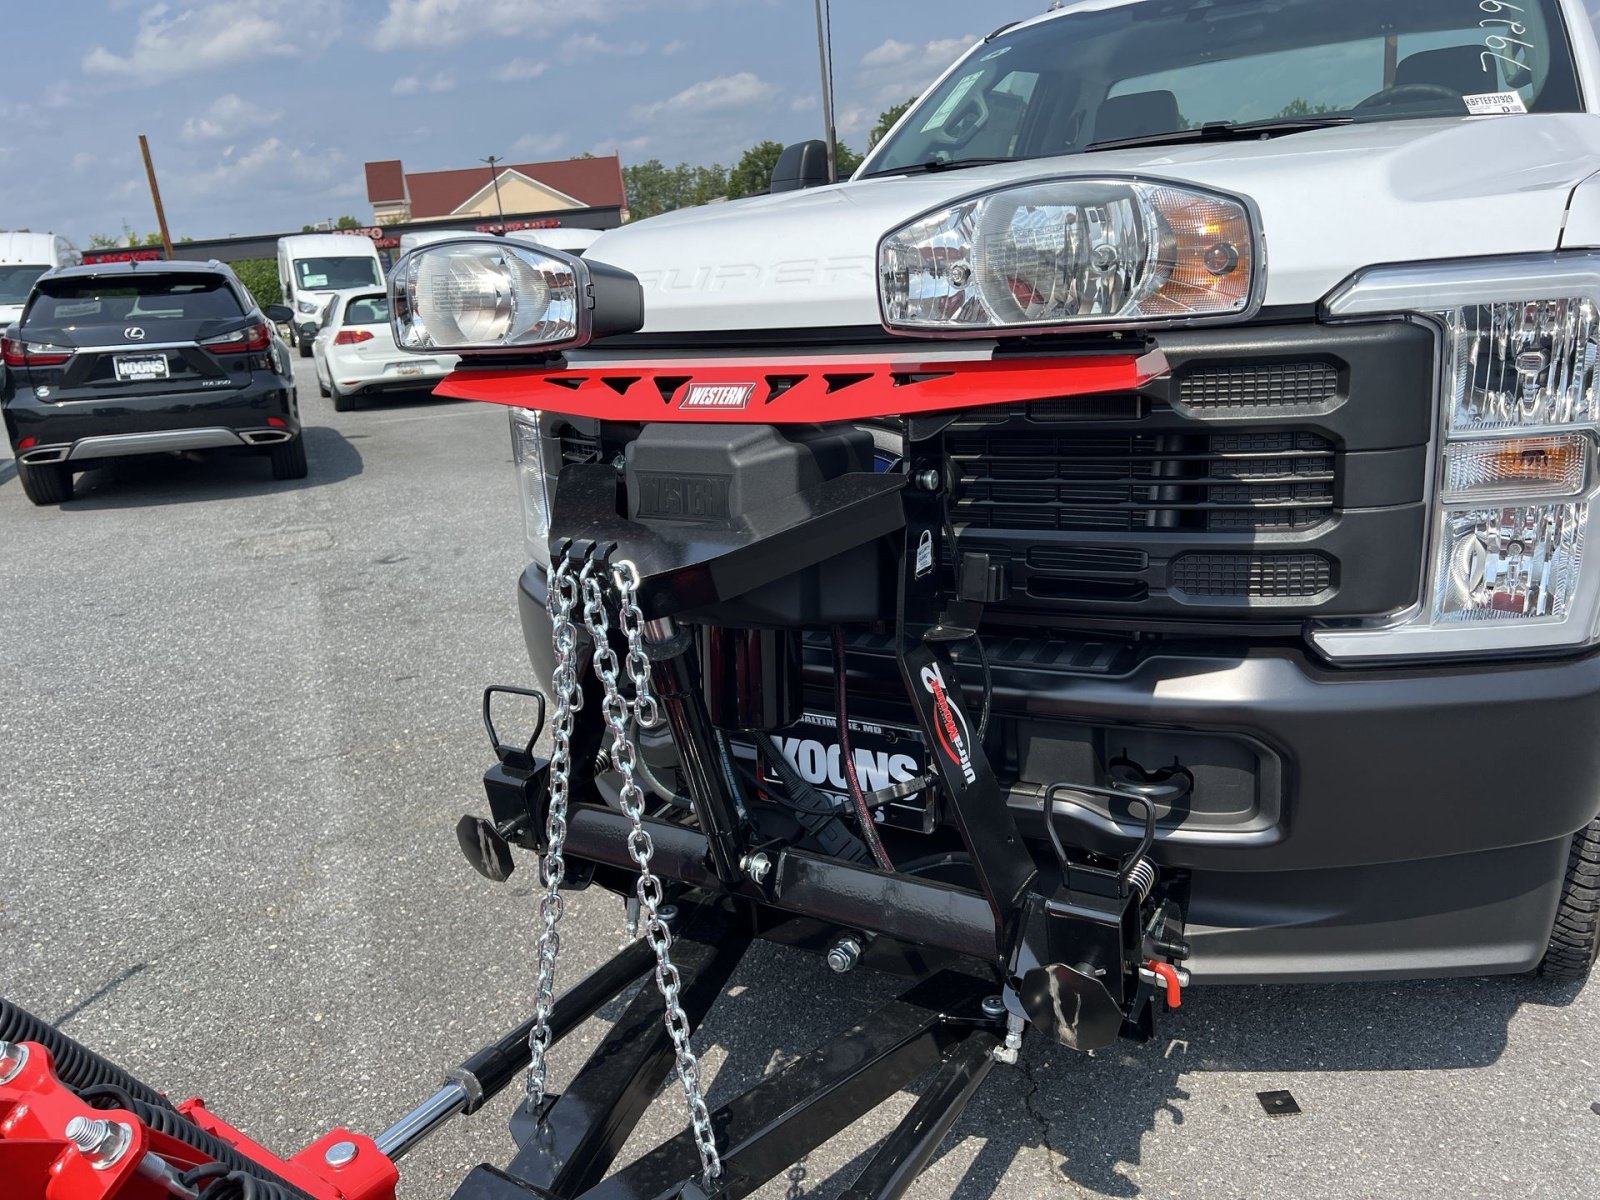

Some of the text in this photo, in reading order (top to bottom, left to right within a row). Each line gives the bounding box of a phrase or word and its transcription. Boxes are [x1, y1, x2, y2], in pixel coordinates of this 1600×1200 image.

[1480, 0, 1534, 72] 7929
[119, 360, 165, 374] KOONS
[688, 386, 748, 405] WESTERN
[920, 662, 948, 694] 2
[863, 724, 882, 734] MD
[769, 735, 918, 800] KOONS
